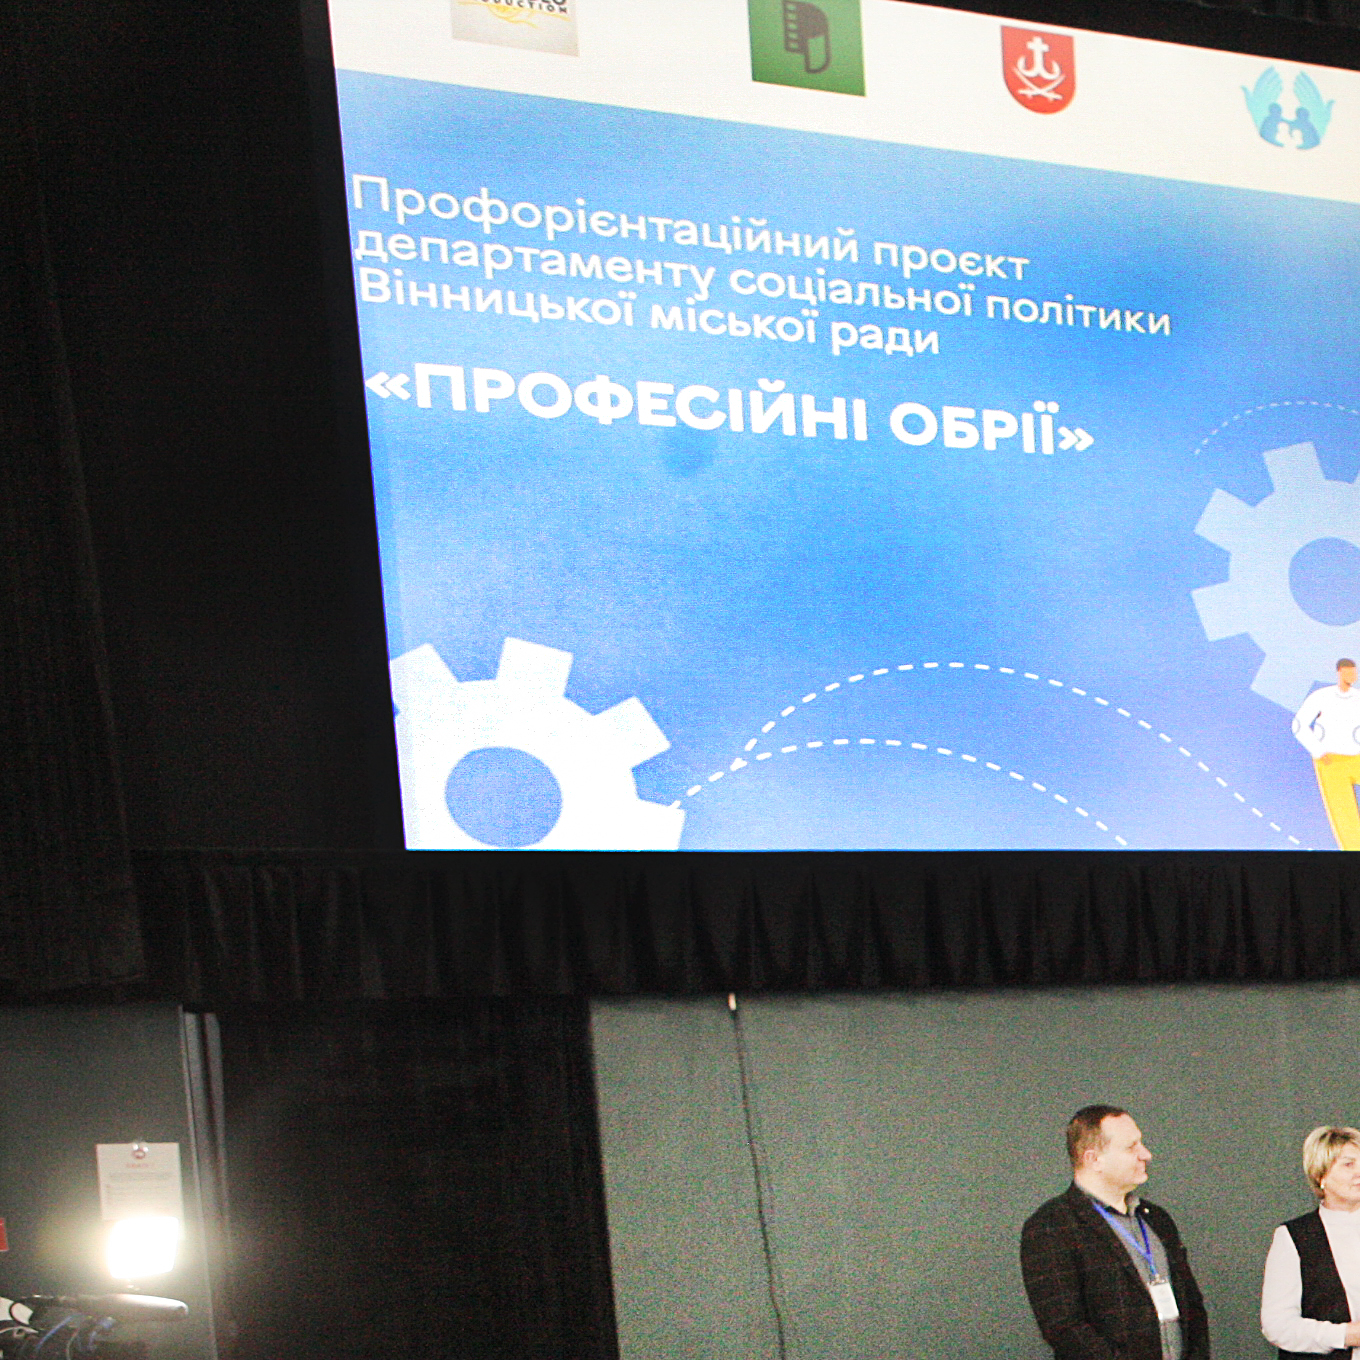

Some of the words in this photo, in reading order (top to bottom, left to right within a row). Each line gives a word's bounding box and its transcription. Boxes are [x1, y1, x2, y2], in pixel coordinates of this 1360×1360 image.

[352, 174, 858, 264] Профорієнтаційний
[874, 241, 1029, 280] проєкт
[354, 229, 716, 301] департаменту
[729, 268, 976, 316] соціальної
[986, 294, 1171, 336] політики
[359, 266, 635, 327] Вінницької
[650, 297, 818, 343] міської
[831, 320, 939, 356] ради
[365, 363, 867, 442] «ПРОФЕСІЙНІ
[890, 400, 1094, 455] ОБРІЇ»
